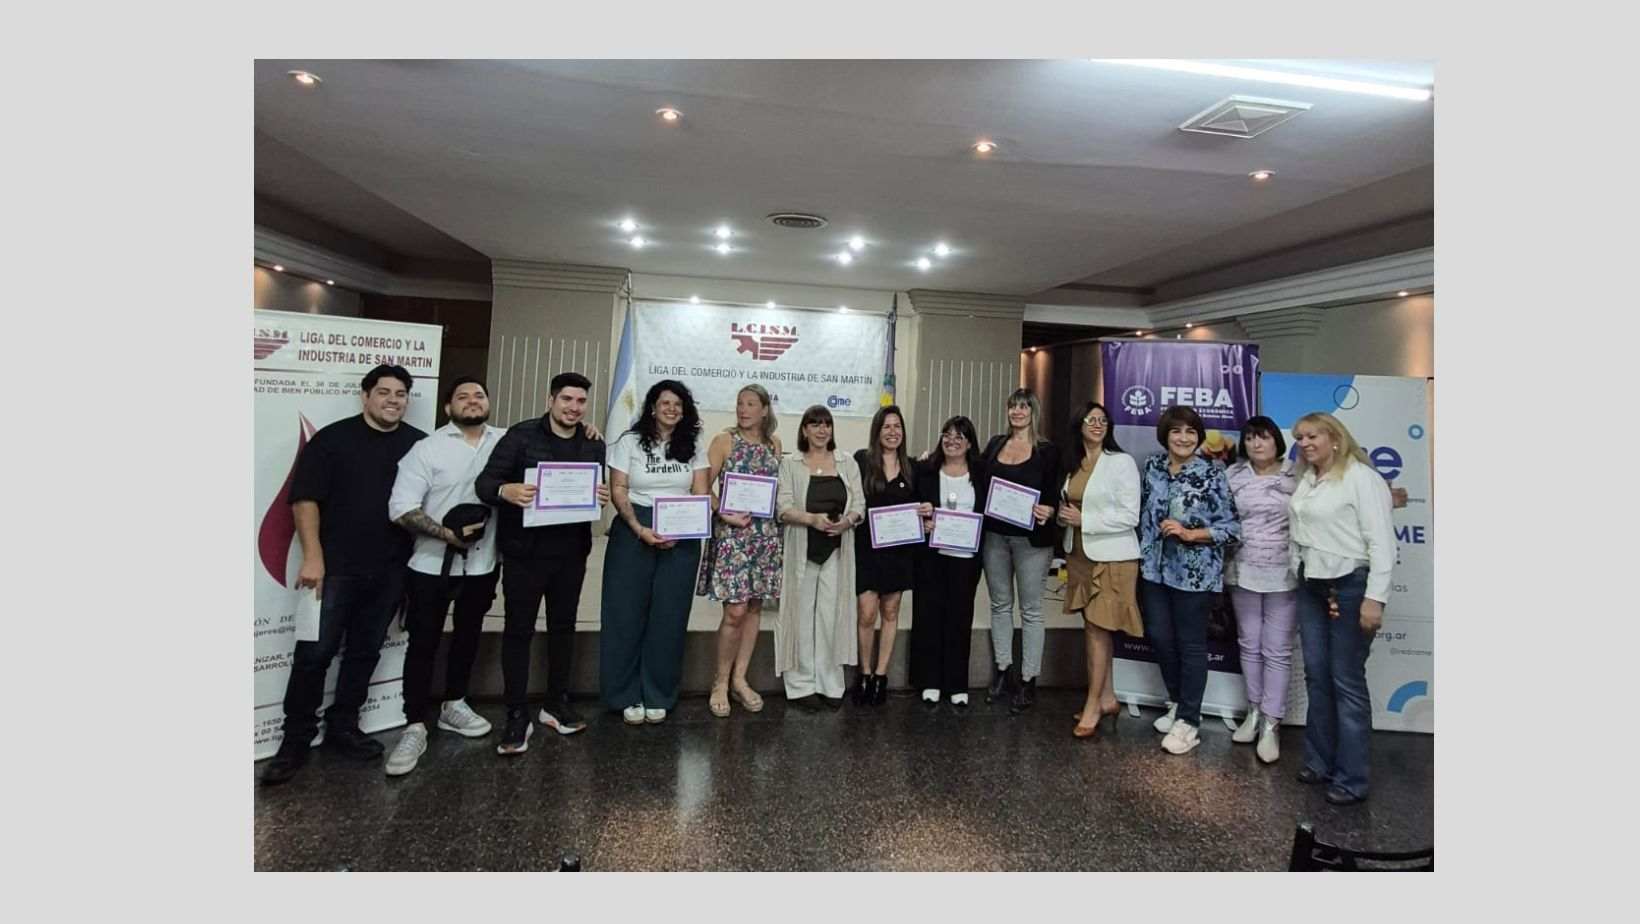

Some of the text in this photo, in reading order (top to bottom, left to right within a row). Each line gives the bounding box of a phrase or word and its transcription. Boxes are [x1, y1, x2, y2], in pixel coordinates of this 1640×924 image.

[300, 332, 425, 352] LIGA DEL COMERCIO Y LA
[298, 349, 433, 369] INDUSTRIA DE SAN MARTIN
[648, 365, 873, 385] LIGA DEL COMERCIO Y LA INDUSTRIA DE SAN MARTIN
[267, 386, 280, 394] DE
[281, 387, 302, 395] BIEN
[1160, 386, 1234, 408] FEBA
[1124, 405, 1152, 416] FEBA
[646, 453, 661, 465] The
